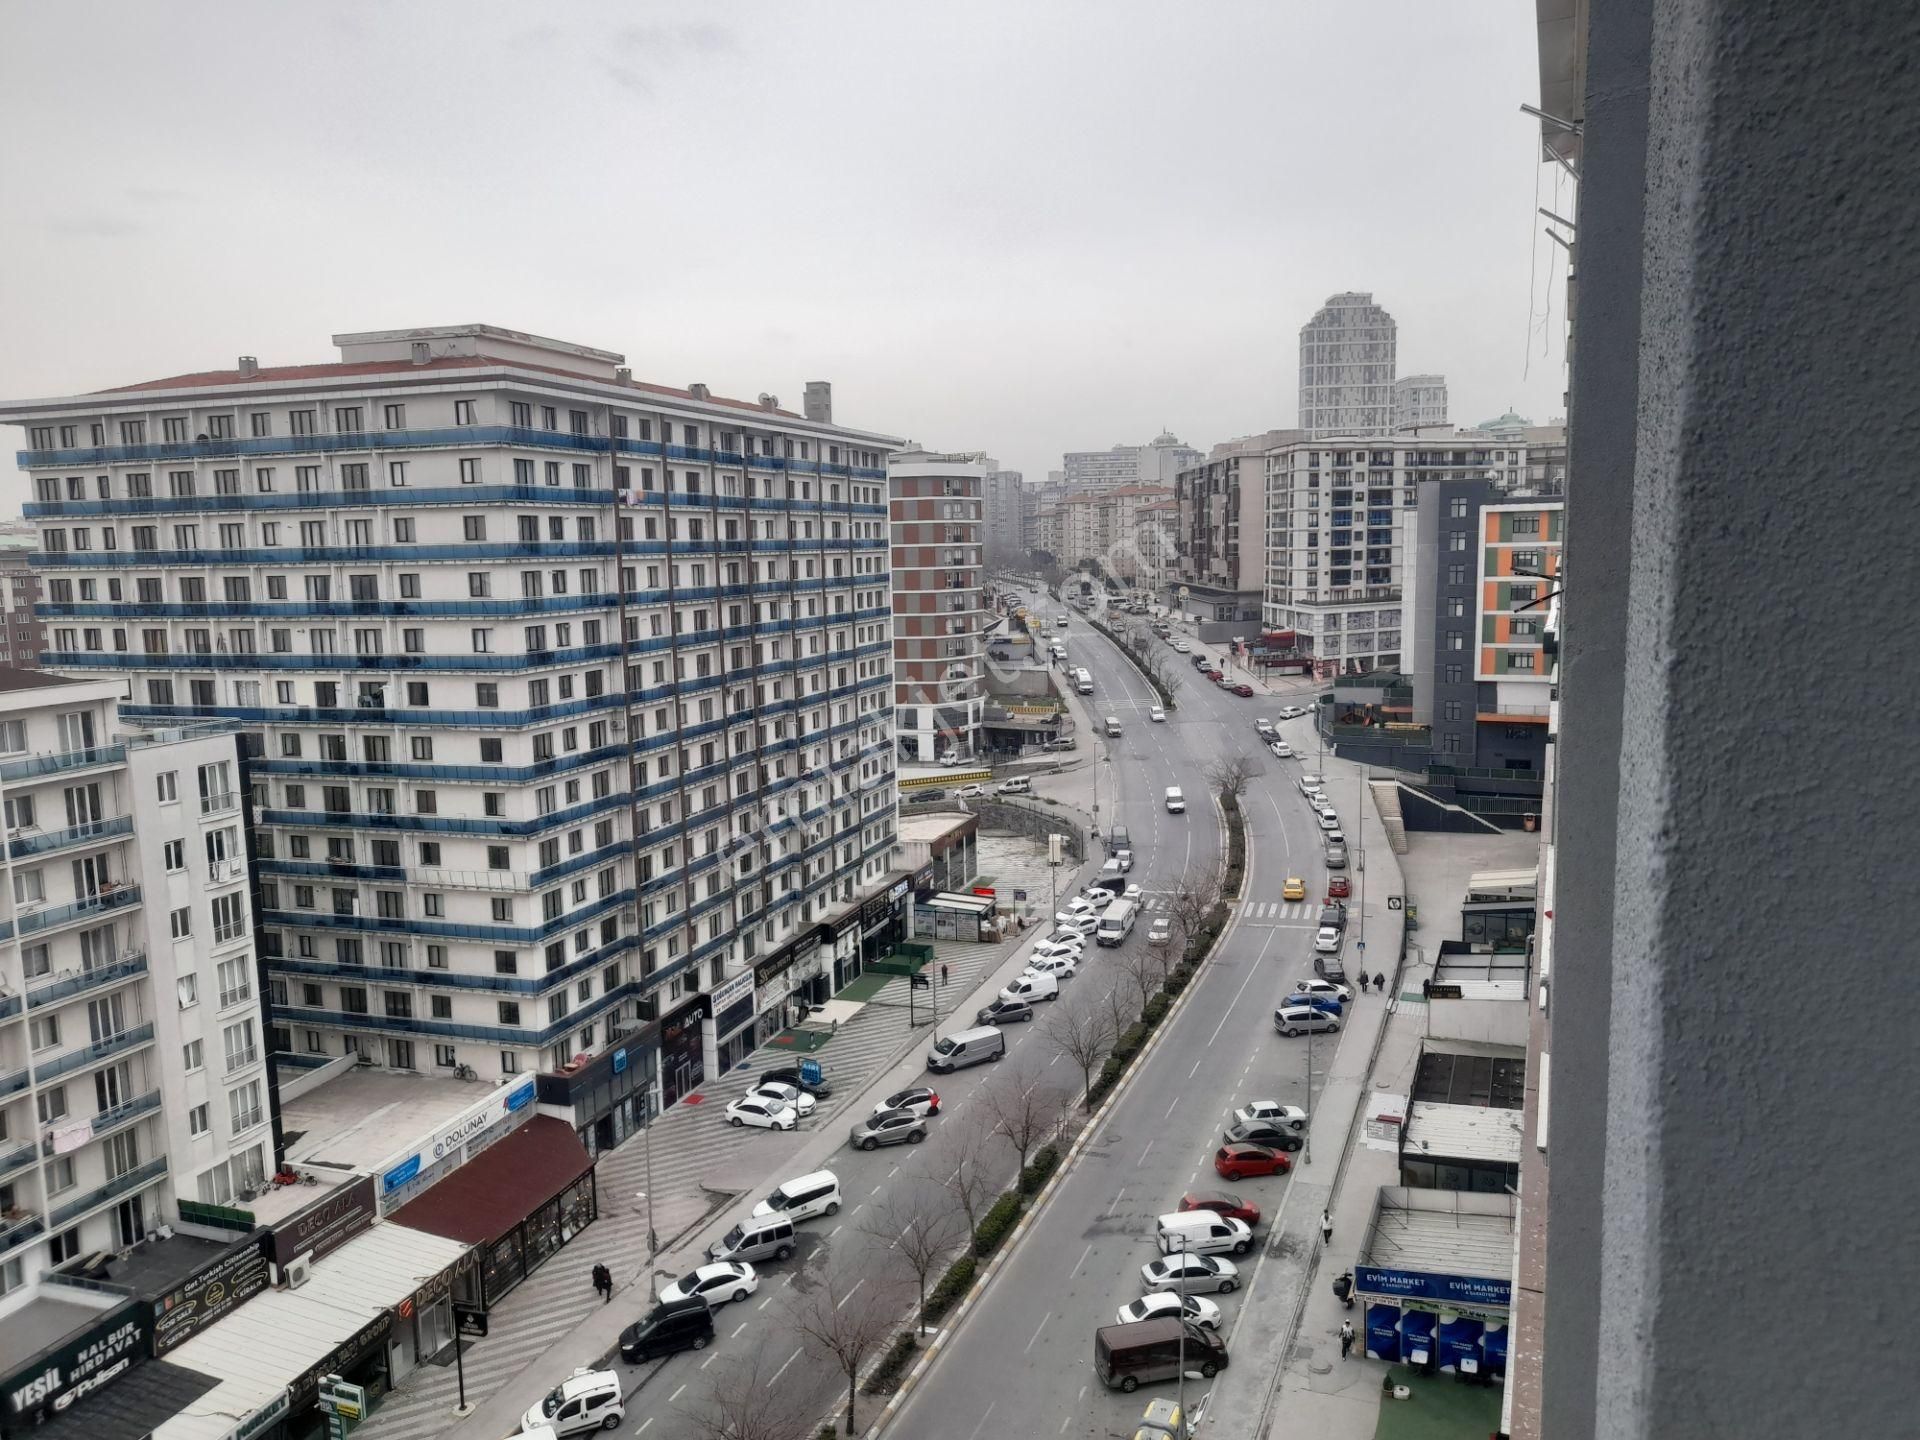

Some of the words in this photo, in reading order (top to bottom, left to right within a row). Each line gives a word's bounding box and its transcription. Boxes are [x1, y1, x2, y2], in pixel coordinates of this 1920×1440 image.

[684, 1008, 703, 1028] AUTO
[445, 1112, 488, 1148] DOLUNAY
[199, 1264, 223, 1283] Turkish
[416, 1268, 453, 1307] DECO
[1366, 1273, 1387, 1283] EVİM
[1389, 1276, 1425, 1287] MARKET
[1449, 1281, 1472, 1291] EVİM
[1473, 1284, 1511, 1295] MARKET
[69, 1327, 142, 1383] HIRDAVAT
[77, 1321, 135, 1364] NALBUR
[12, 1367, 63, 1412] YEŞİL
[76, 1357, 130, 1398] Polisan
